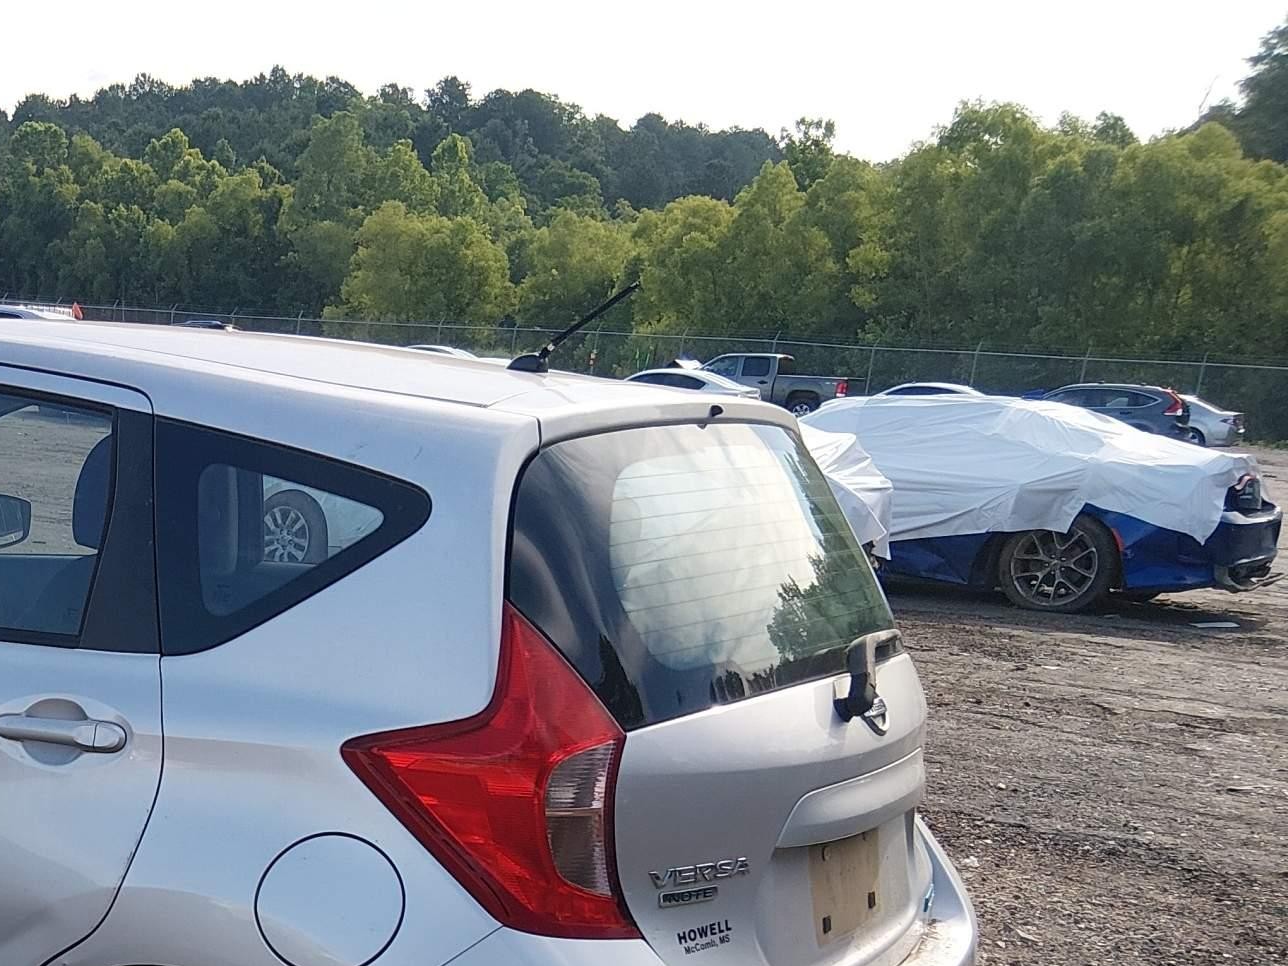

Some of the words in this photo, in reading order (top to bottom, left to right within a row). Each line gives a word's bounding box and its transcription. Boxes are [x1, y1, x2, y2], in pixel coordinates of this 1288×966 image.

[648, 857, 749, 889] VERSA
[677, 920, 732, 945] HOWELL
[684, 939, 718, 955] McComb,
[719, 934, 730, 945] MS
